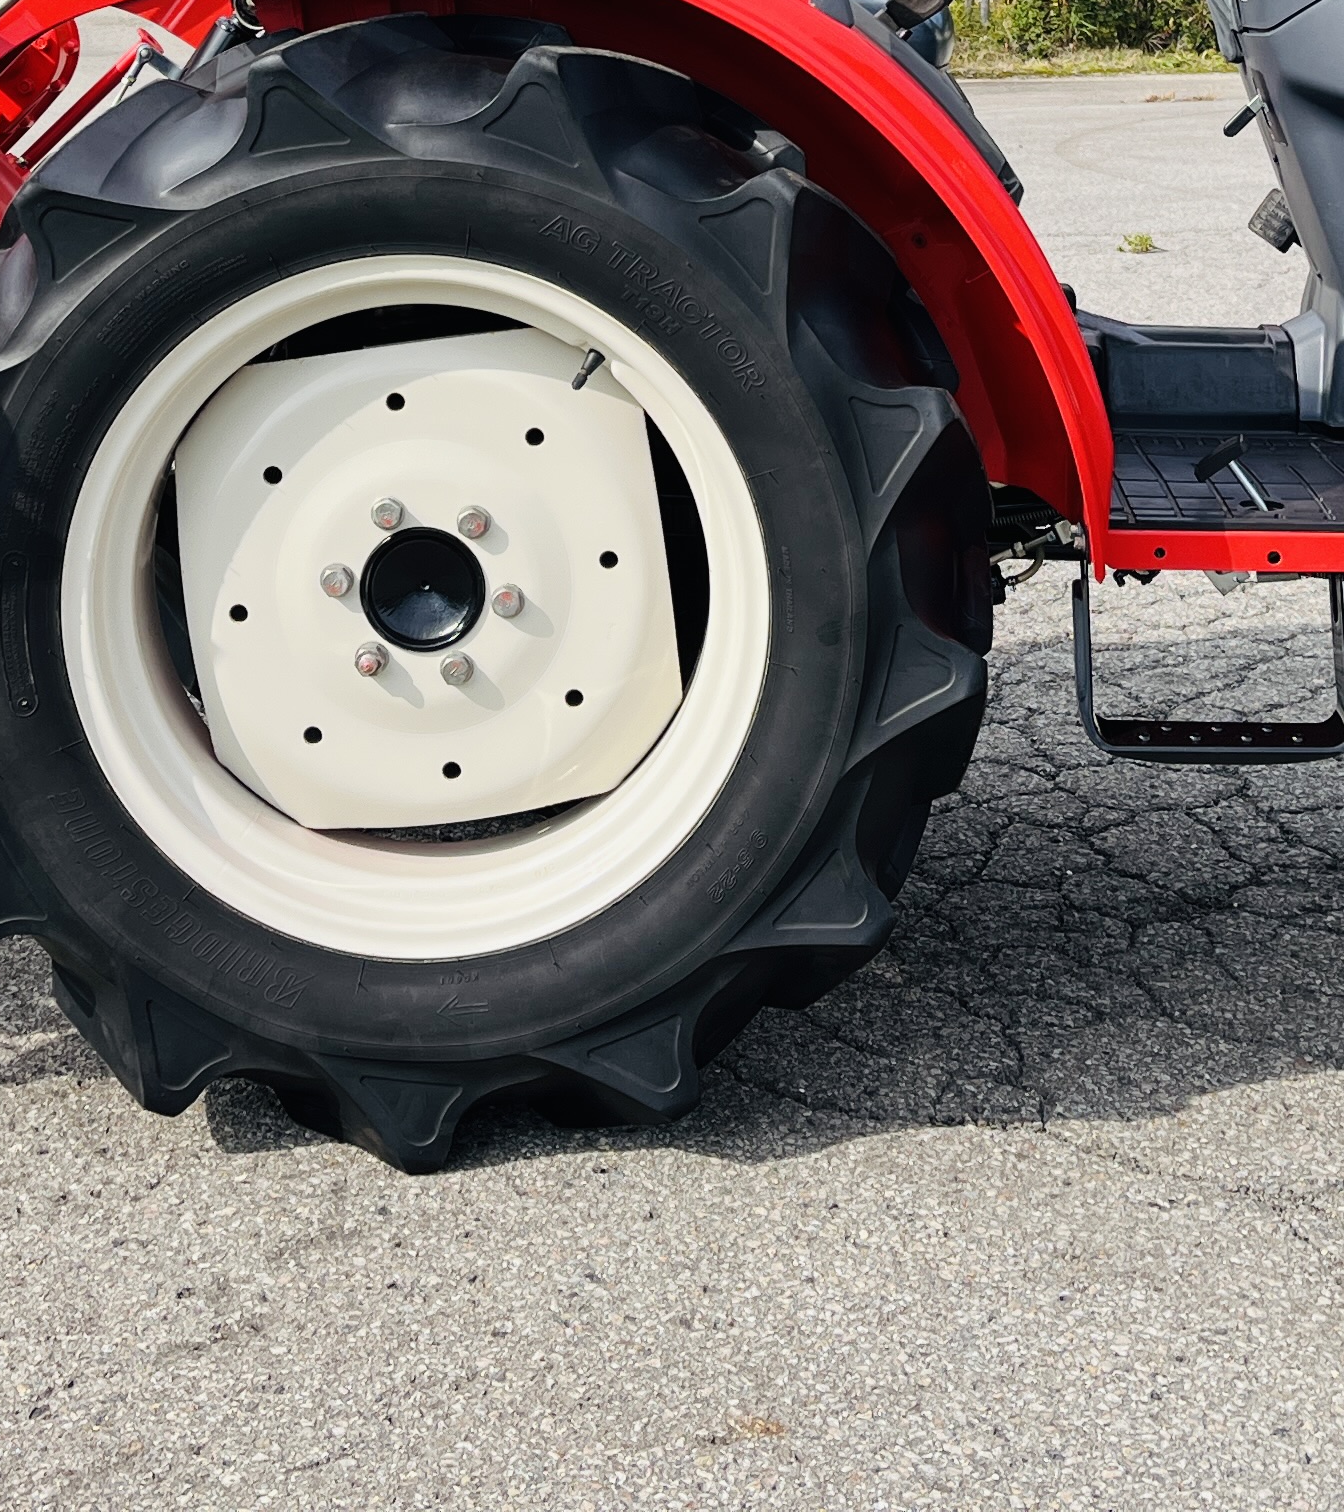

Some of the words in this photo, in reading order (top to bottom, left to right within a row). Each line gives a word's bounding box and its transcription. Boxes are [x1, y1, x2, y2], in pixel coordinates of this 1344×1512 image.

[537, 214, 602, 256] AG
[606, 240, 768, 394] TRACTOR
[46, 786, 316, 1009] BRIDGESTONE
[706, 828, 768, 904] 9.5-22
